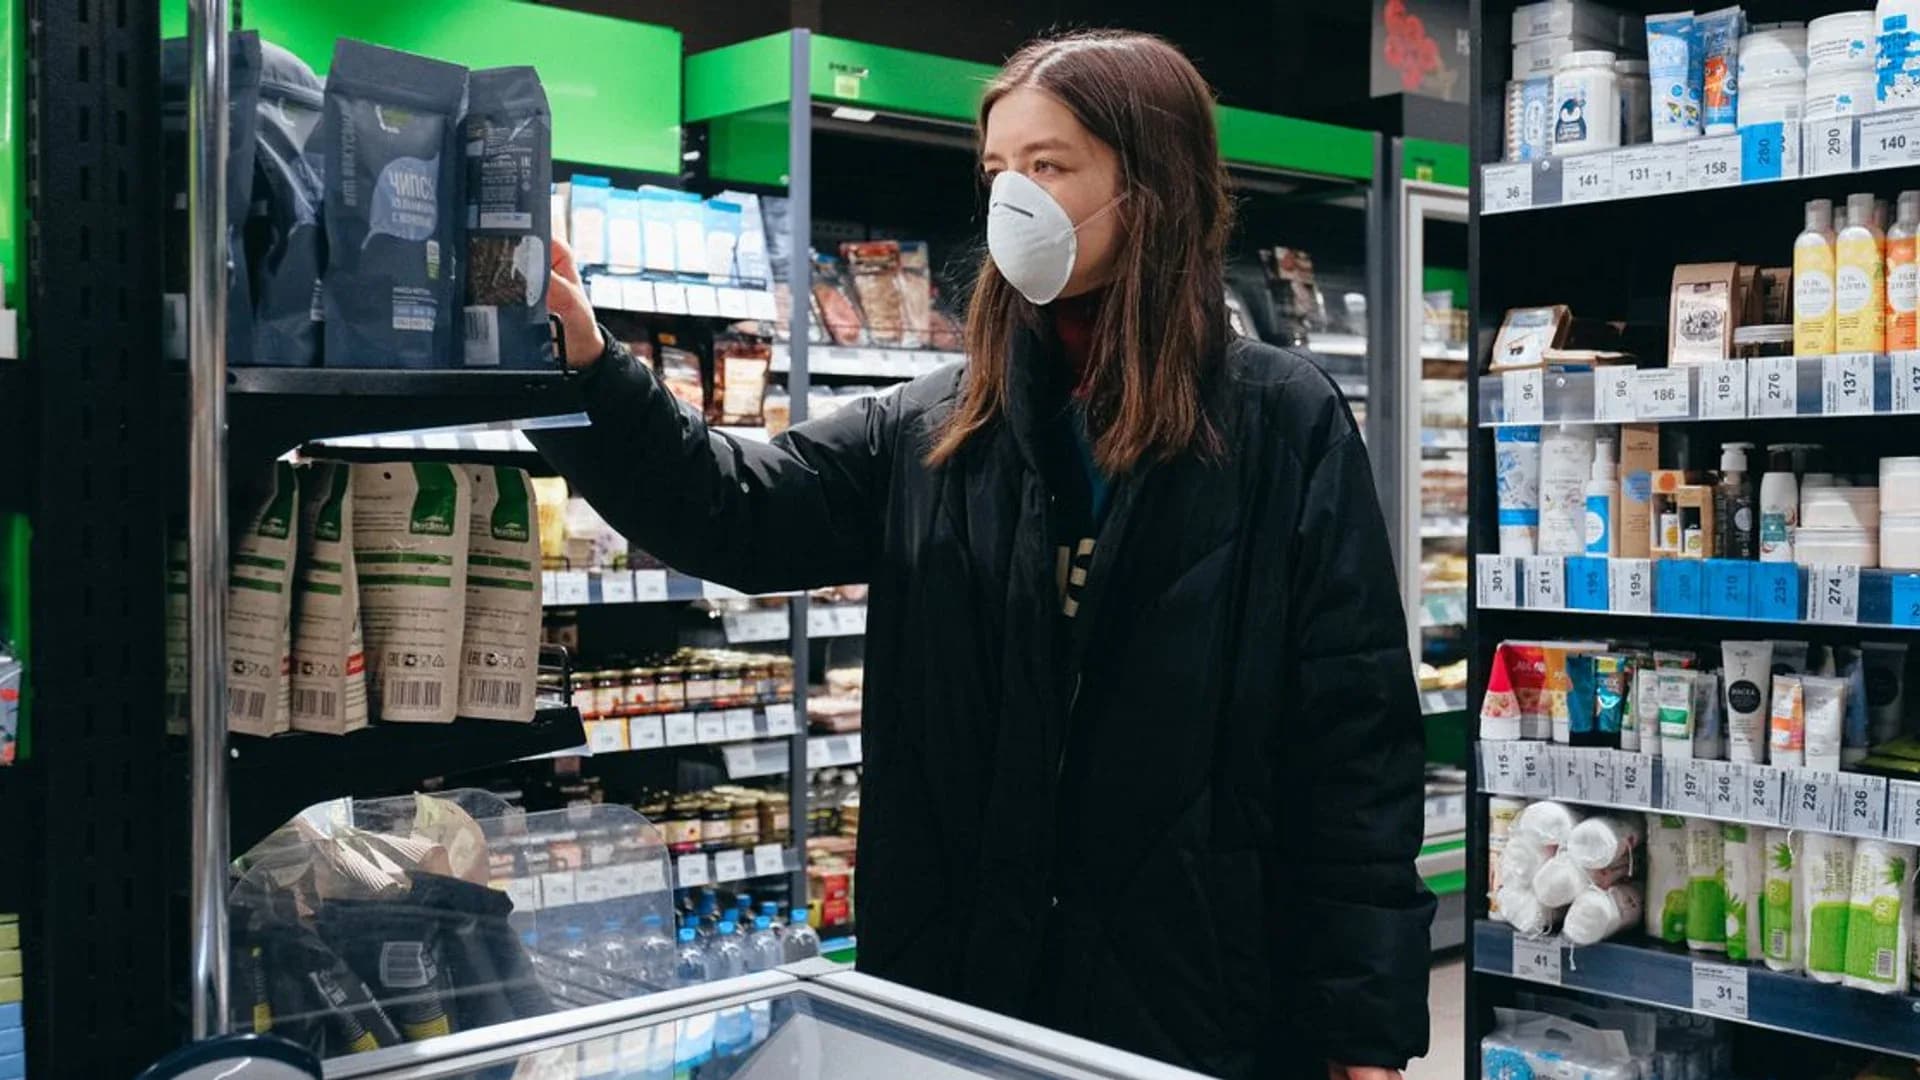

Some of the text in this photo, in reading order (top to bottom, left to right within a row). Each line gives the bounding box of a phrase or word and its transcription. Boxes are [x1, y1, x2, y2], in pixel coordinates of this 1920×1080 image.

[1828, 128, 1840, 155] 290
[1880, 135, 1906, 150] 140
[1629, 168, 1649, 181] 131
[1704, 162, 1727, 174] 158
[1579, 174, 1598, 187] 141
[1506, 187, 1520, 199] 36
[1523, 383, 1533, 400] 96
[1616, 381, 1627, 397] 96
[1719, 375, 1730, 400] 185
[1769, 374, 1781, 399] 276
[1844, 370, 1856, 396] 137
[1653, 389, 1676, 401] 186
[1493, 570, 1503, 592] 301
[1541, 571, 1550, 594] 211
[1631, 573, 1641, 597] 195
[1828, 578, 1841, 605] 274
[1499, 755, 1509, 776] 115
[1525, 756, 1536, 777] 161
[1595, 763, 1604, 779] 77
[1625, 766, 1636, 790] 162
[1685, 773, 1696, 798] 197
[1719, 777, 1730, 802] 246
[1753, 779, 1765, 806] 246
[1803, 783, 1817, 810] 228
[1854, 790, 1868, 818] 236
[1534, 955, 1548, 967] 41
[1716, 985, 1732, 999] 31
